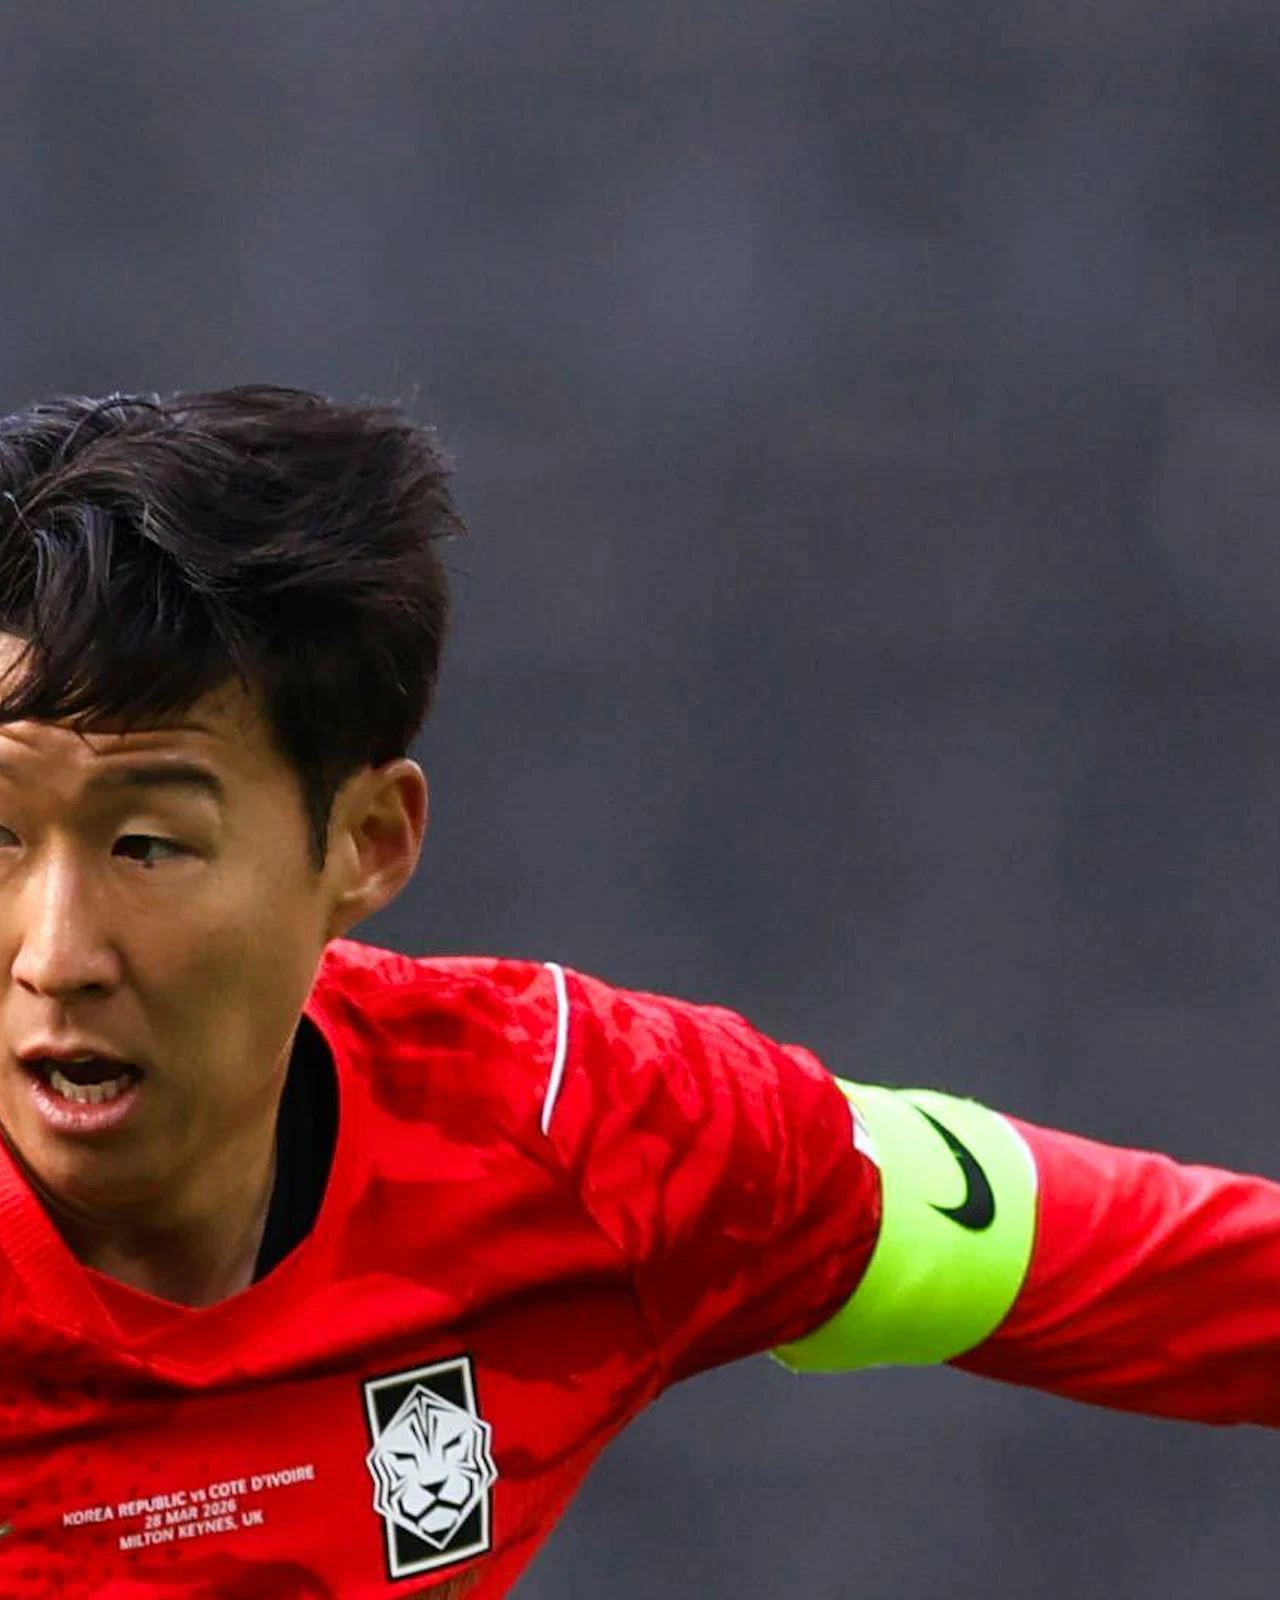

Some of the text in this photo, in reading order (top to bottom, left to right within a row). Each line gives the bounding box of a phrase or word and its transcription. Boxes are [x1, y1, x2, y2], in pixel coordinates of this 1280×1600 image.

[63, 1506, 114, 1527] KOREA
[118, 1490, 187, 1518] REPUBLIC
[208, 1478, 248, 1499] COTE
[251, 1464, 316, 1491] D'IVOIRE
[144, 1498, 237, 1530] 28 MAR 2026
[119, 1510, 264, 1551] MILTON KEYNES, UK
